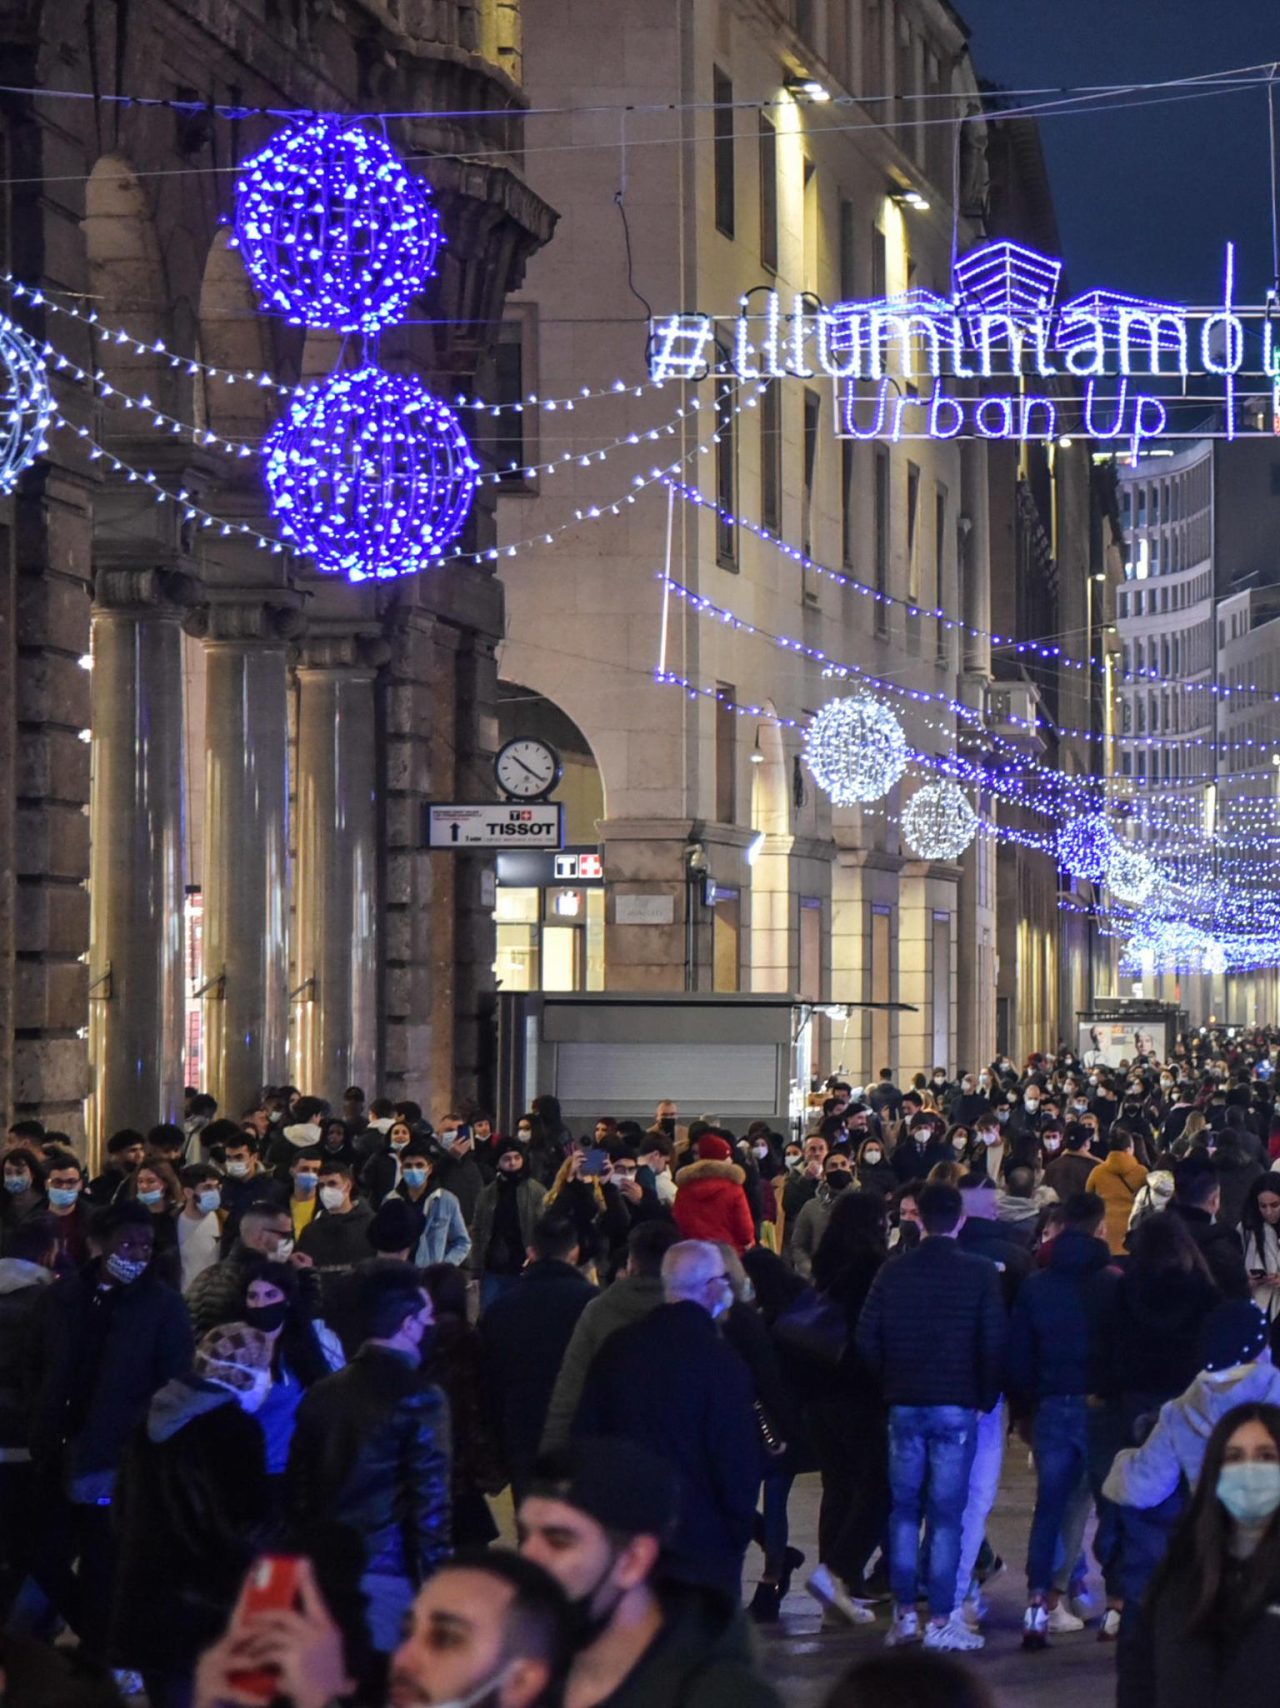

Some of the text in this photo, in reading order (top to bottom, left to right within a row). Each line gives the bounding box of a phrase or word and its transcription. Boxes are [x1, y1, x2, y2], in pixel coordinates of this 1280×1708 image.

[846, 377, 1056, 442] Urban
[1086, 377, 1167, 468] Up
[485, 823, 555, 836] TISSOT
